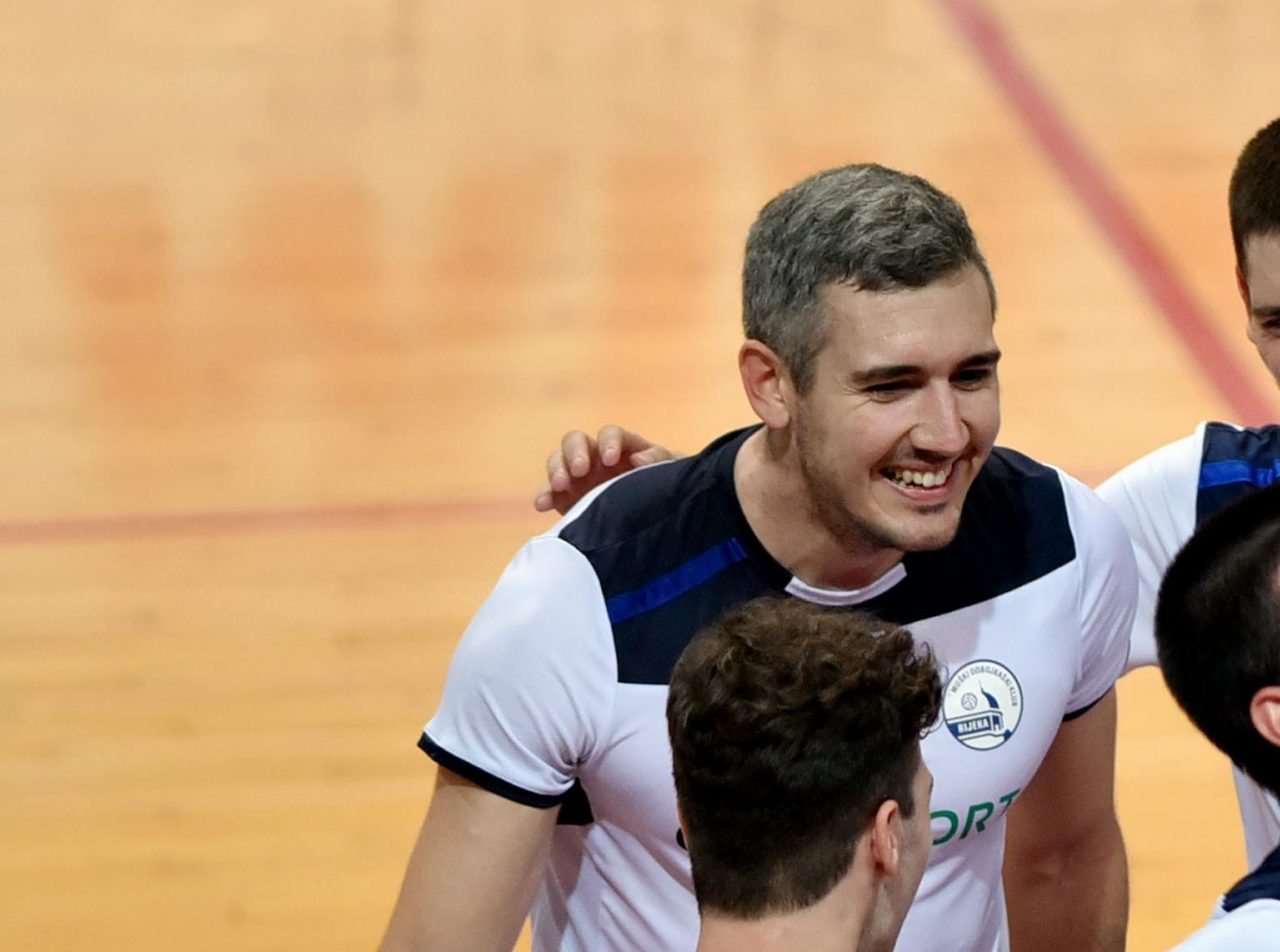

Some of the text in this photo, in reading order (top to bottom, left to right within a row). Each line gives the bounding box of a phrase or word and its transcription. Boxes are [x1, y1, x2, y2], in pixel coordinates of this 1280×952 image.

[1009, 686, 1018, 707] KLUB
[957, 717, 990, 734] RIJEKA
[930, 787, 1021, 846] ORT
